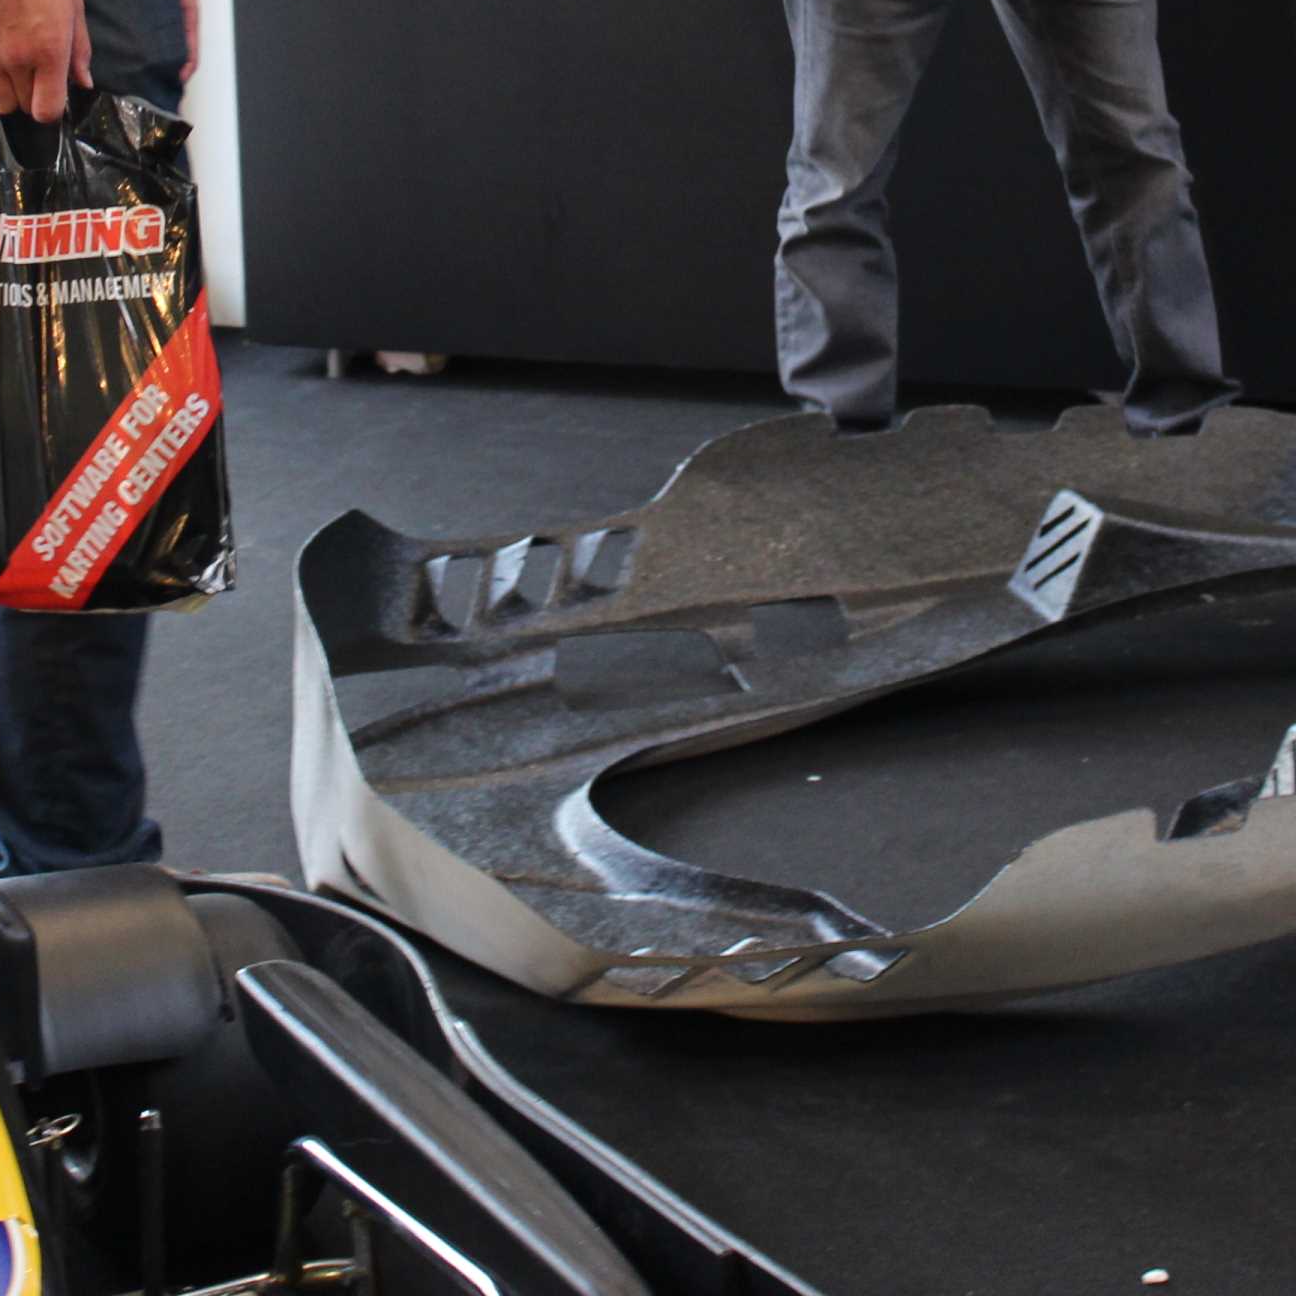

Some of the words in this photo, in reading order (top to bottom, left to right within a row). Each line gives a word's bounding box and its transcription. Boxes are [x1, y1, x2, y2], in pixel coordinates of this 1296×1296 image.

[36, 282, 48, 306] &
[50, 271, 176, 304] MANAGEMENT
[32, 432, 130, 561] SOFTWARE
[118, 384, 170, 440] FOR
[49, 501, 128, 598] KARTING
[117, 393, 209, 505] CENTERS
